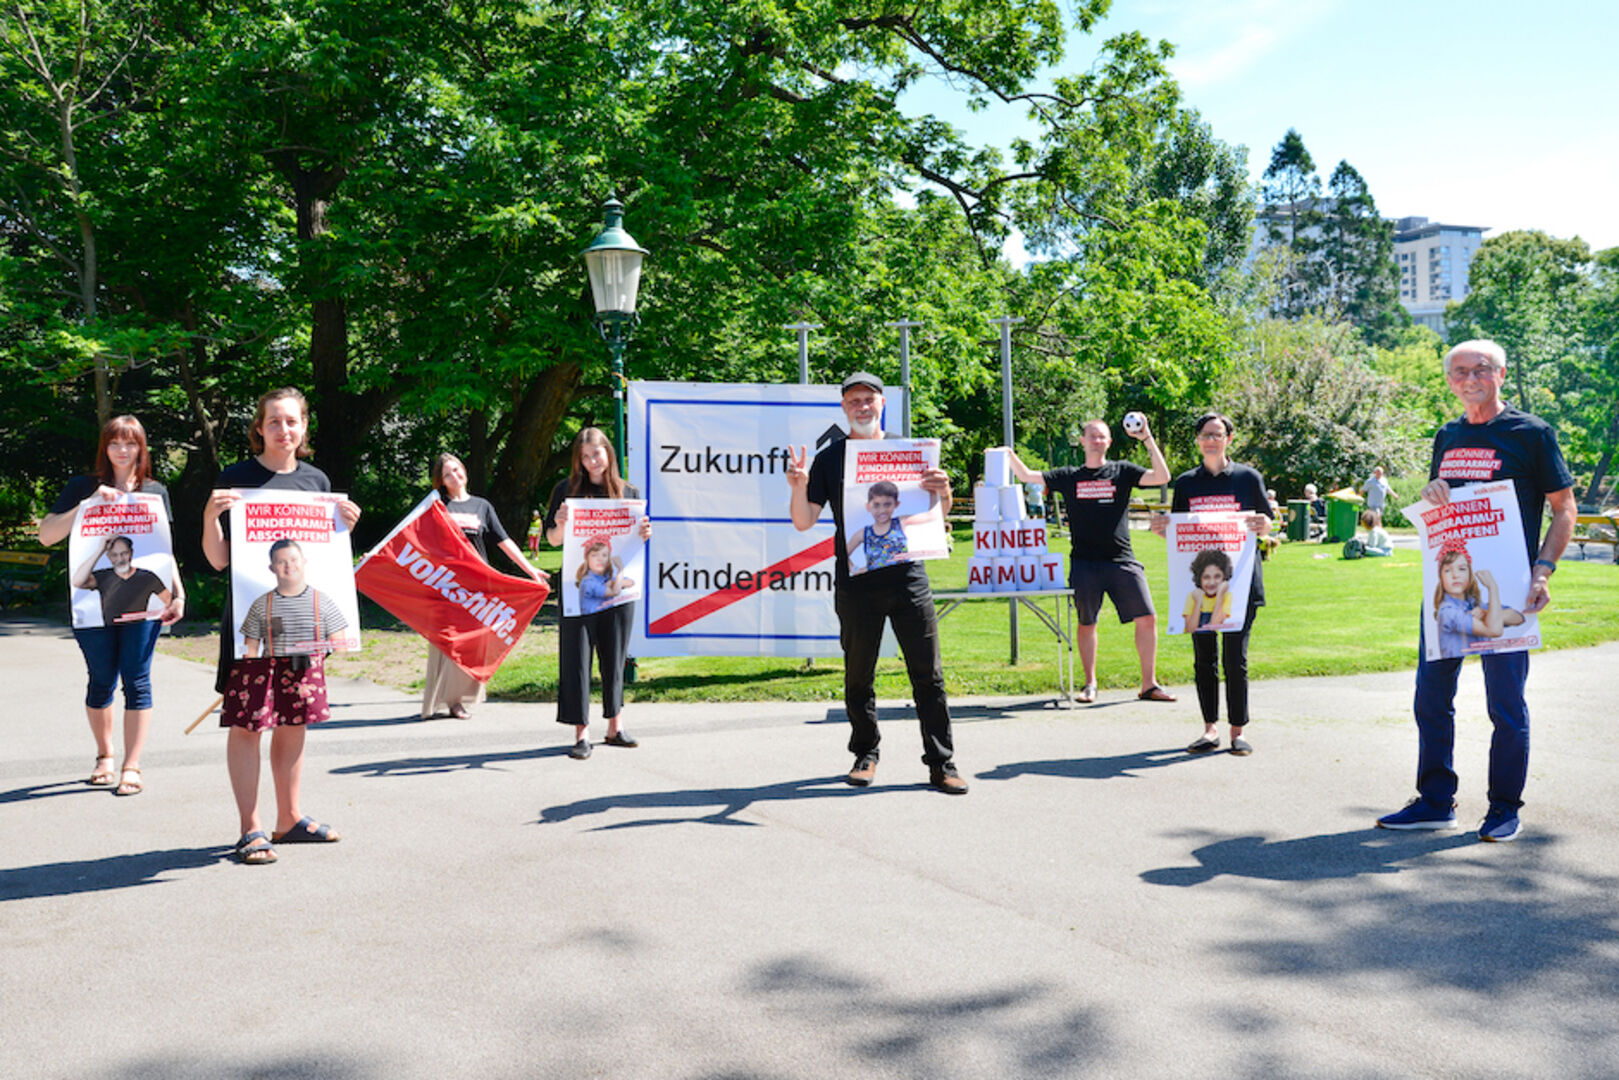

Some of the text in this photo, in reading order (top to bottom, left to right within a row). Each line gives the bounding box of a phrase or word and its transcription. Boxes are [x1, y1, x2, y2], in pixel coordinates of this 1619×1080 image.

[660, 445, 791, 474] Zukunft
[858, 451, 921, 462] WIR KÖNNEN
[858, 463, 928, 472] KINDERARMUT
[104, 504, 148, 516] KÖNNEN
[247, 503, 325, 517] WIR KÖNNEN
[83, 513, 157, 525] KINDERARMUT
[247, 518, 335, 530] KINDERARMUT
[82, 525, 152, 536] ABSCHAFFEN!
[1197, 523, 1238, 532] KÖNNEN
[247, 530, 329, 541] ABSCHAFFEN!
[1177, 533, 1245, 541] KINDERARMUT
[1178, 542, 1240, 550] ABSCHAFFEN!
[658, 562, 832, 591] Kinderarm
[969, 562, 1059, 584] ARMUT
